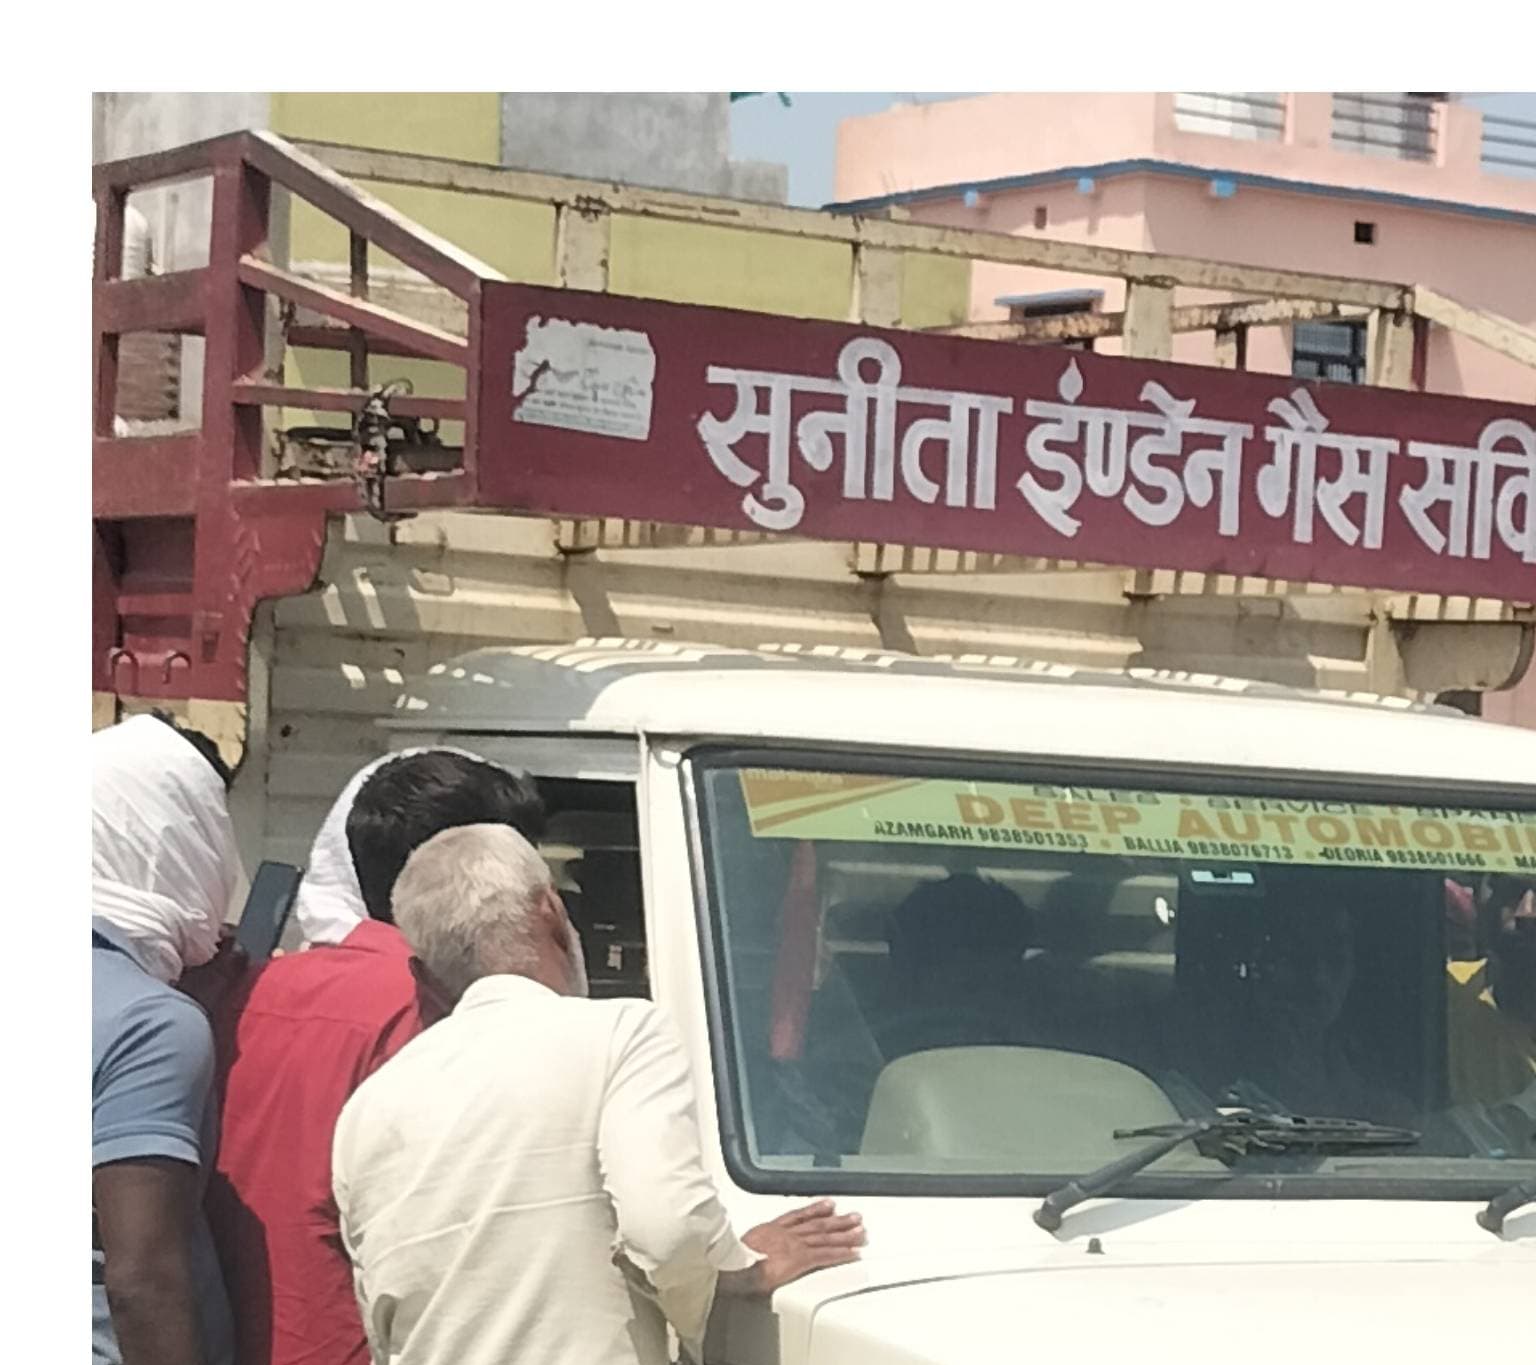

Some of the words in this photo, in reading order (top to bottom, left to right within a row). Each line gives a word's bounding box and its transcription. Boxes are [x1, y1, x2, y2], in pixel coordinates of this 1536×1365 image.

[697, 337, 1014, 531] सुनीता
[1256, 387, 1400, 549] गैस
[955, 793, 1141, 834] DEEP
[874, 819, 974, 841] AZAMGARH
[1123, 836, 1185, 855] BALLIA
